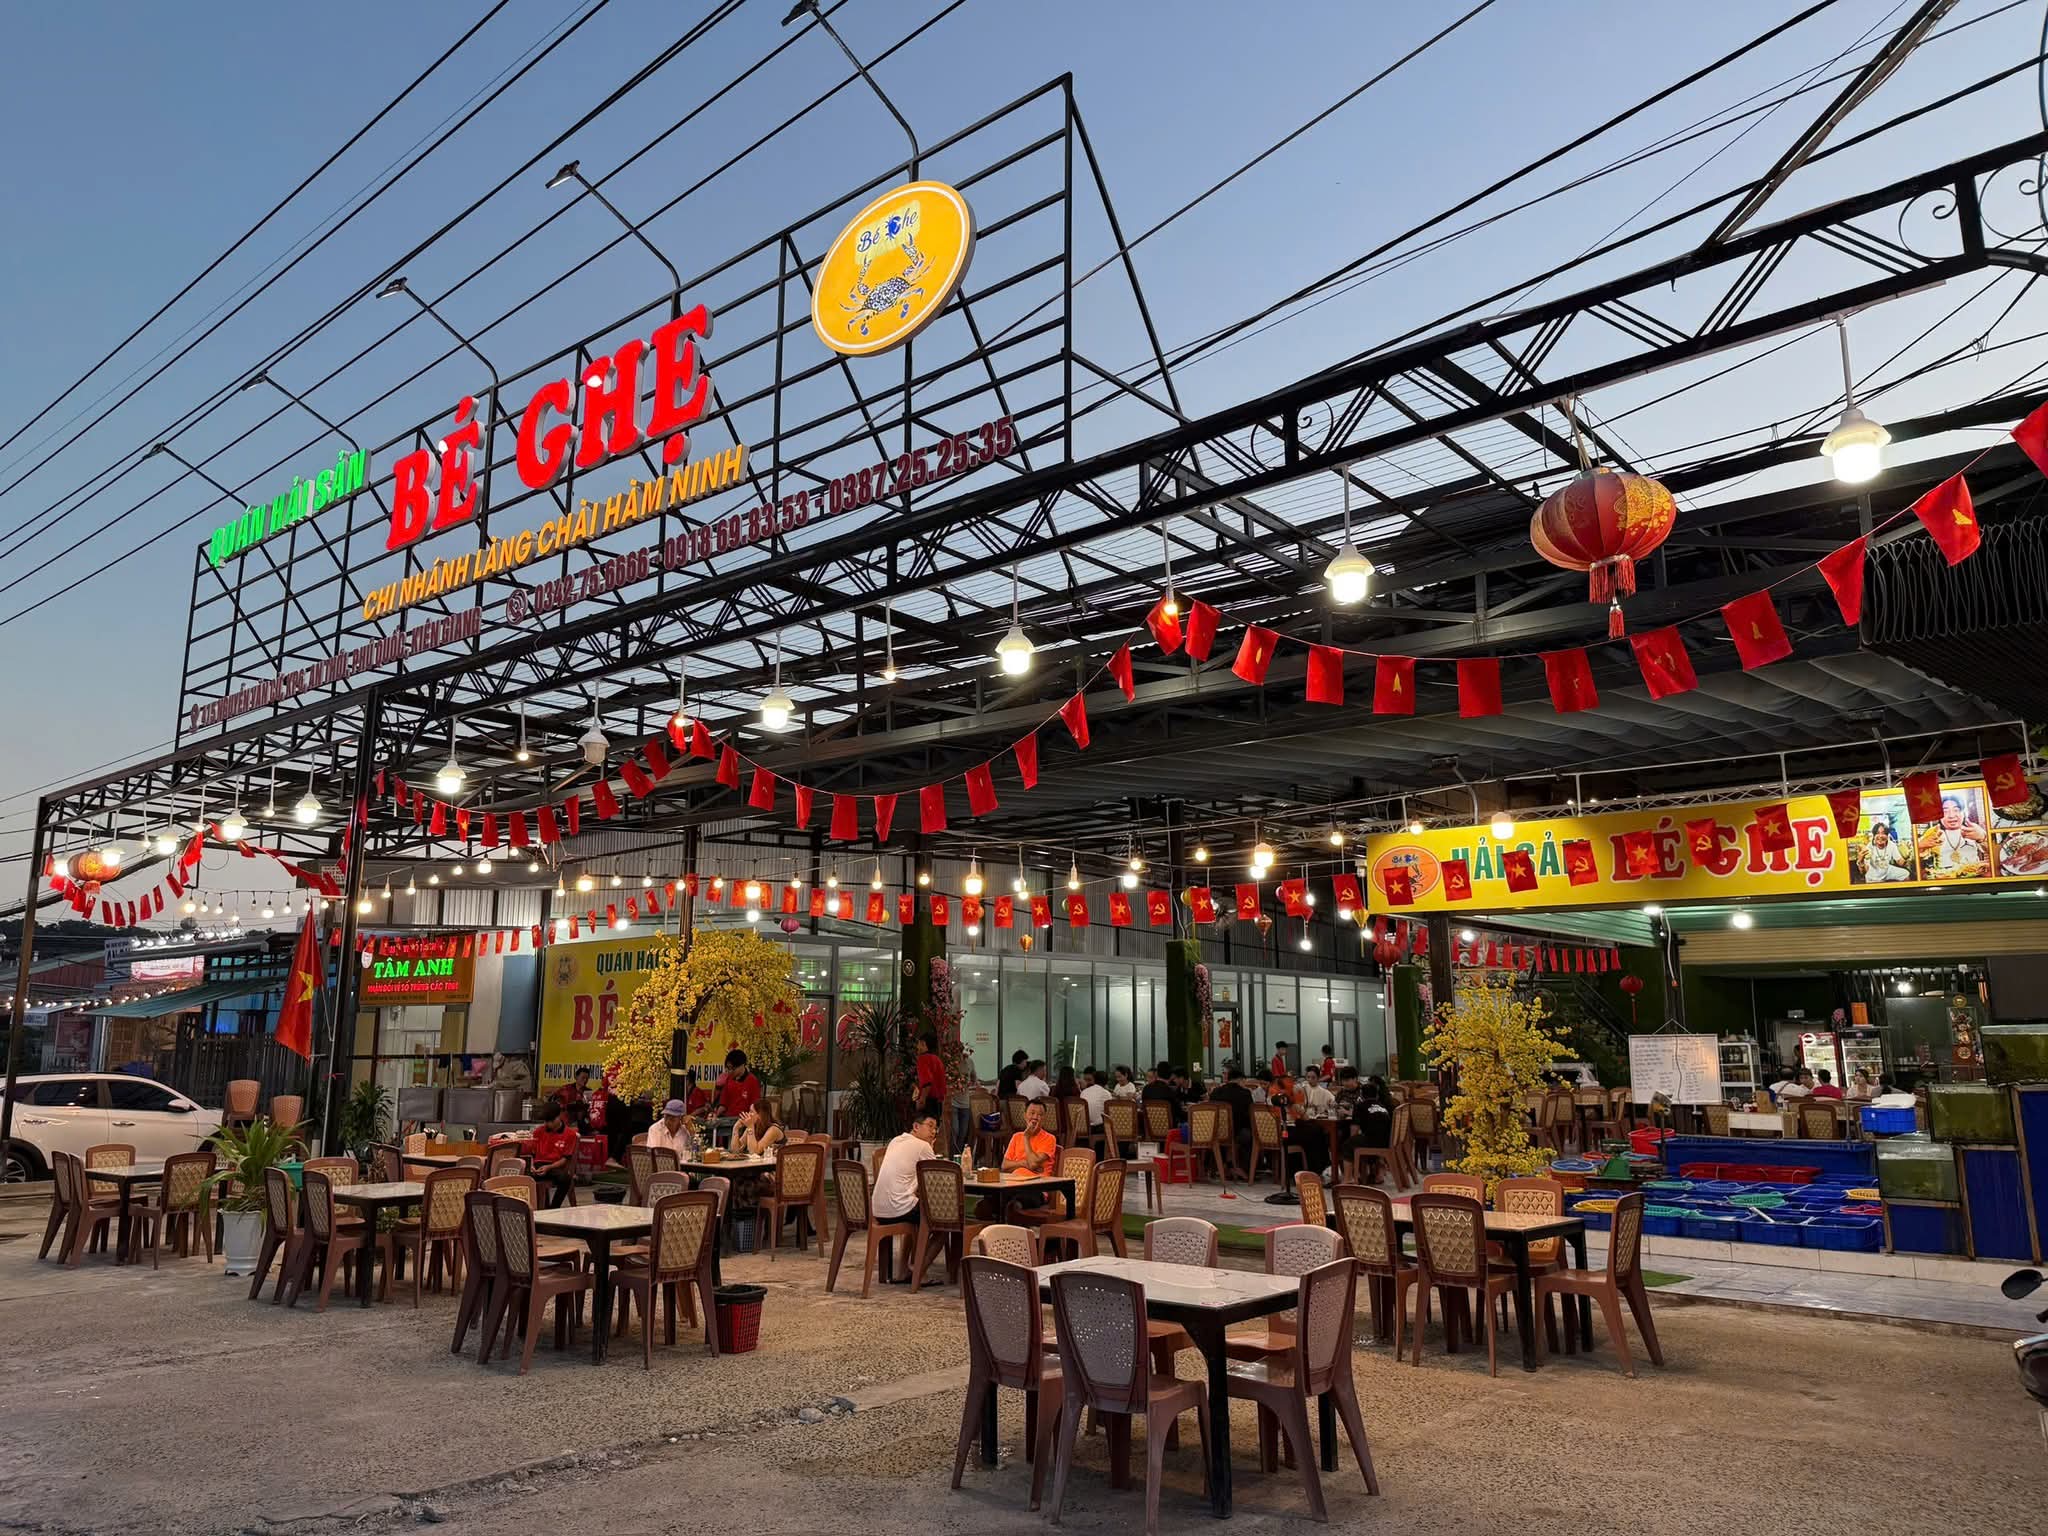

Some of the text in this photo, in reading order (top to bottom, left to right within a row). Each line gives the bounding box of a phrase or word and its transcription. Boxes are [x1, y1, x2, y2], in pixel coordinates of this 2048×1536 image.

[385, 303, 713, 550] BÉ GHẸ
[209, 448, 368, 568] QUÁN HẢI SẢN
[362, 443, 745, 621] CHI NHÁNH LÀNG CHÀI HÀM NINH
[534, 547, 650, 615] 0342.75.6666
[664, 524, 712, 570] 0918
[828, 414, 1014, 515] 0387.25.25.35
[352, 639, 376, 675] PHÚ
[410, 617, 441, 653] KIÊN
[442, 606, 482, 646] GIANG
[374, 957, 454, 978] TÂM ANH
[597, 949, 631, 975] QUÁN
[571, 979, 619, 1041] BÉ
